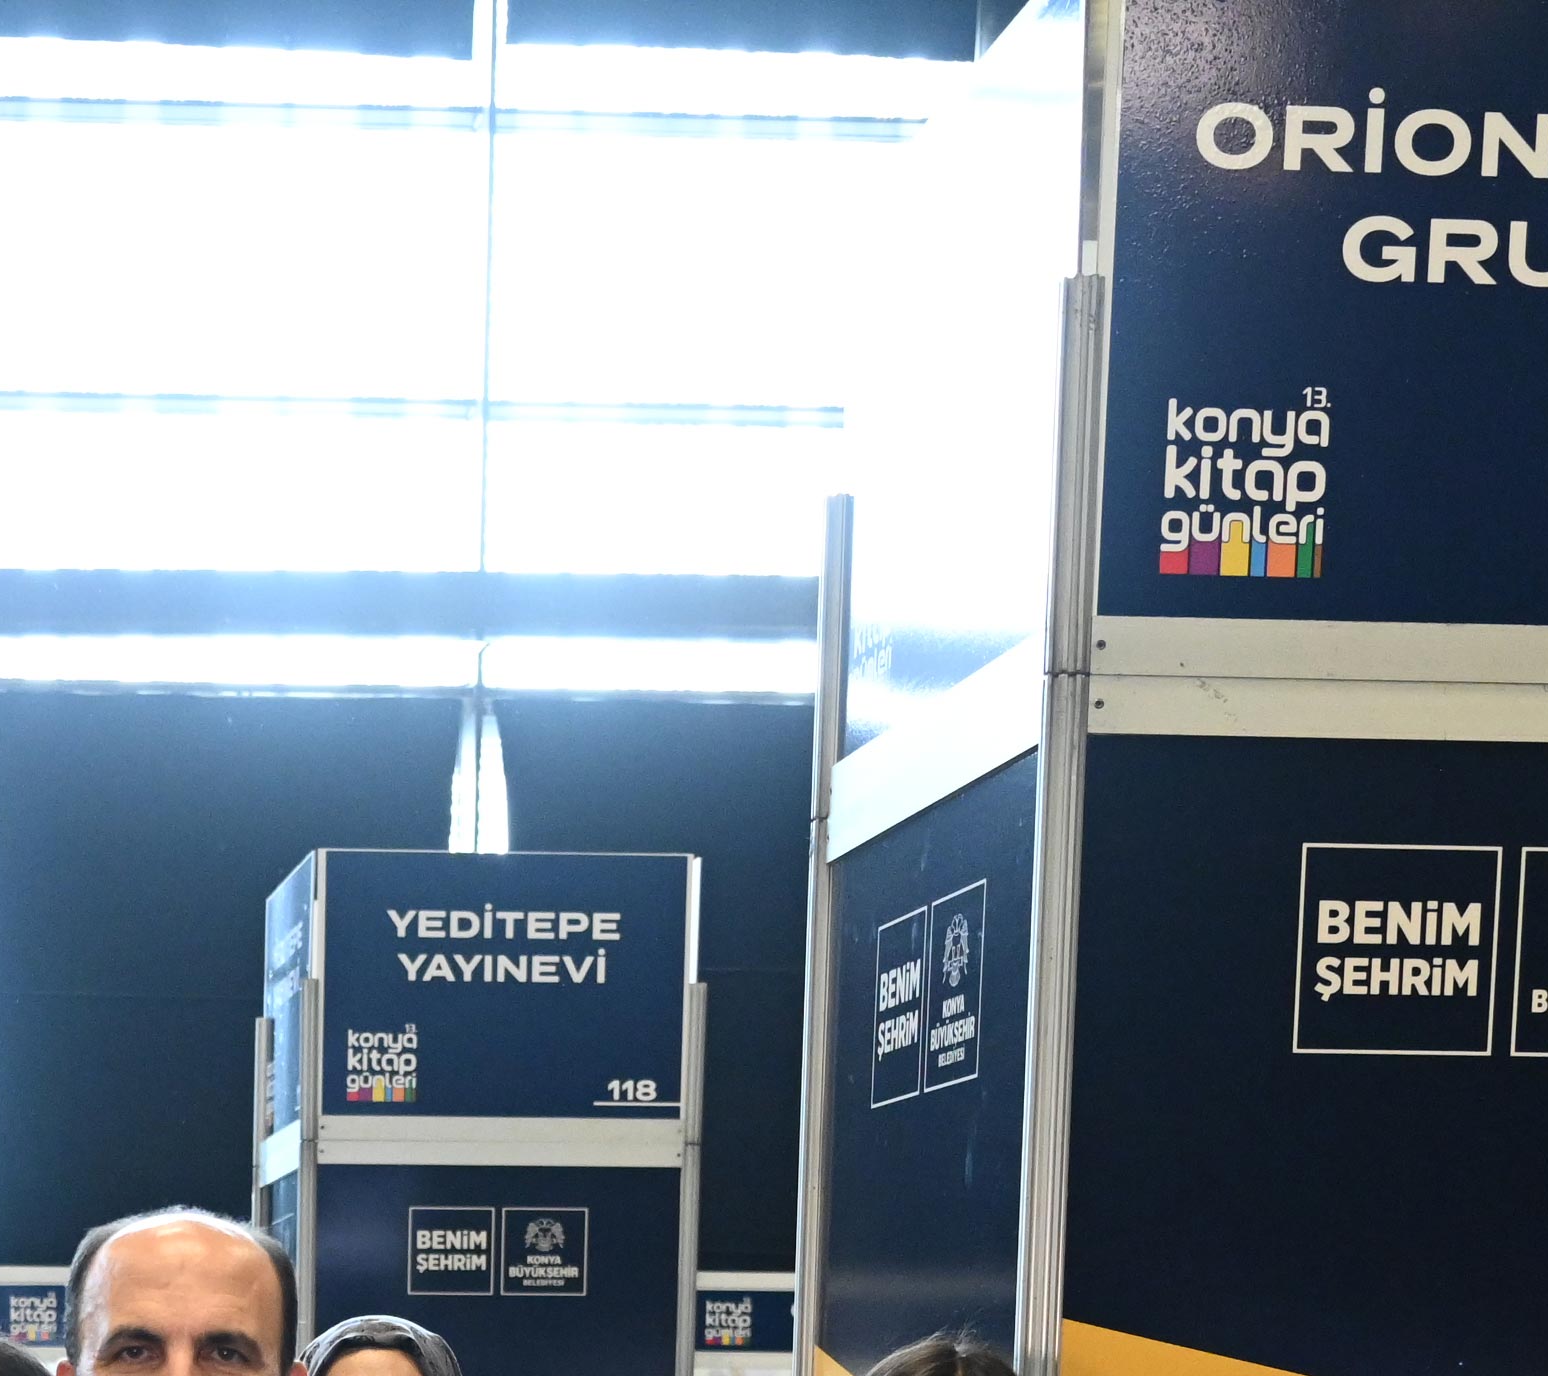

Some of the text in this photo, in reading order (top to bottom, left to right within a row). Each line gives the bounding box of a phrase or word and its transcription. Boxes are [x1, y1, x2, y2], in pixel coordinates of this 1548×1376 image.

[1302, 386, 1332, 408] 13.
[1166, 397, 1330, 459] konya
[1162, 445, 1326, 514] kitap
[1159, 504, 1324, 552] günleri
[387, 902, 621, 942] YEDİTEPE
[1316, 900, 1482, 946] BENİM
[396, 947, 607, 985] YAYINEVİ
[879, 958, 921, 1012] BENİM
[1314, 956, 1479, 1002] ŞEHRİM
[942, 994, 965, 1019] KONYA
[347, 1029, 418, 1053] konya
[877, 1009, 919, 1062] ŞEHRİM
[930, 1011, 976, 1052] BÜYÜKŞEHİR
[347, 1048, 418, 1075] kitap
[346, 1072, 417, 1092] günleri
[607, 1079, 657, 1101] 118
[416, 1230, 487, 1250] BENİM
[416, 1254, 487, 1273] ŞEHRİM
[527, 1255, 561, 1265] KONYA
[9, 1294, 57, 1311] konya
[705, 1300, 752, 1317] konya
[10, 1307, 57, 1325] kitap
[706, 1312, 752, 1329] kitap
